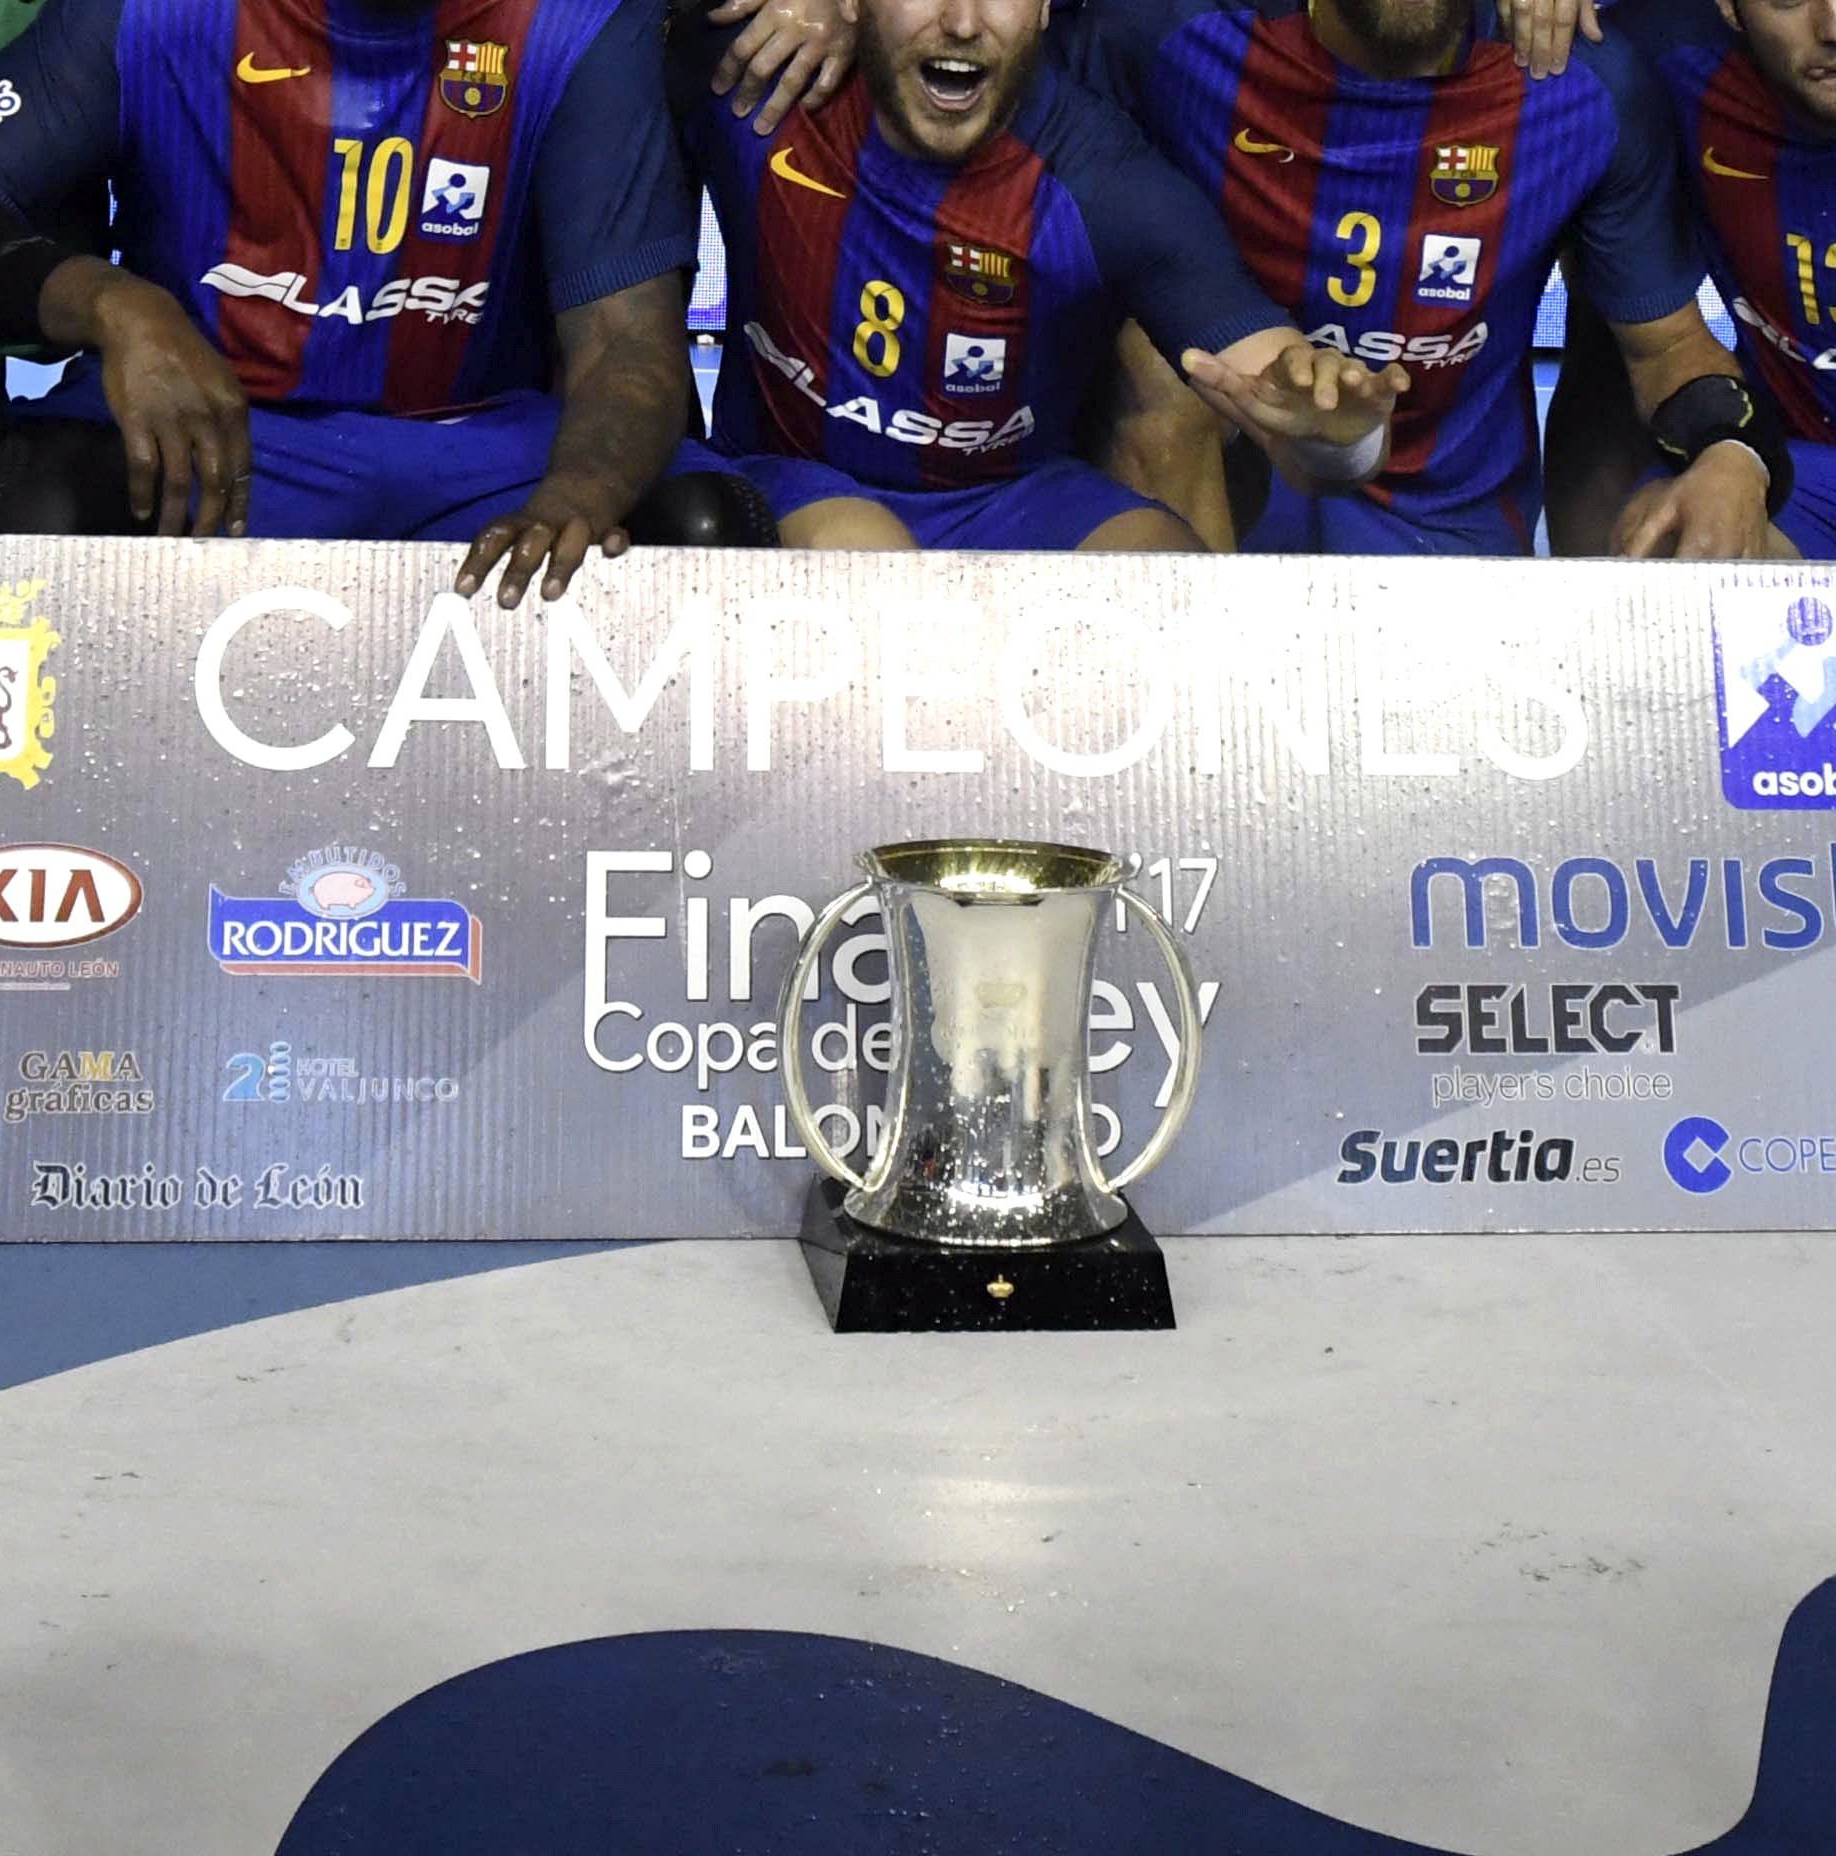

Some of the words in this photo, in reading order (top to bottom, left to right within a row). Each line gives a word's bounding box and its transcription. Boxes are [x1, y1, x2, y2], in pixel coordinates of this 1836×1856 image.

[333, 136, 414, 255] 10
[420, 221, 480, 237] asobal
[1327, 211, 1381, 307] 3
[1418, 285, 1471, 301] asobal
[853, 279, 905, 377] 8
[1306, 320, 1489, 363] ASSA
[792, 364, 1035, 448] LASSA
[945, 381, 1001, 394] asobal
[194, 585, 1589, 781] CAMPEONES
[221, 919, 462, 957] RODRIGUEZ
[585, 850, 892, 1004] Fina
[69, 957, 120, 978] LEÓN
[1415, 983, 1681, 1054] SELECT
[584, 1002, 776, 1089] Copa
[1088, 979, 1221, 1107] ey
[19, 1050, 142, 1082] GAMA
[296, 1058, 359, 1077] HOTEL
[1432, 1066, 1555, 1107] player's
[1564, 1065, 1673, 1100] choice
[4, 1081, 154, 1123] gráficas
[297, 1078, 459, 1104] VALJUNCO
[33, 1162, 181, 1211] Diario
[196, 1163, 244, 1208] de
[257, 1162, 364, 1211] León
